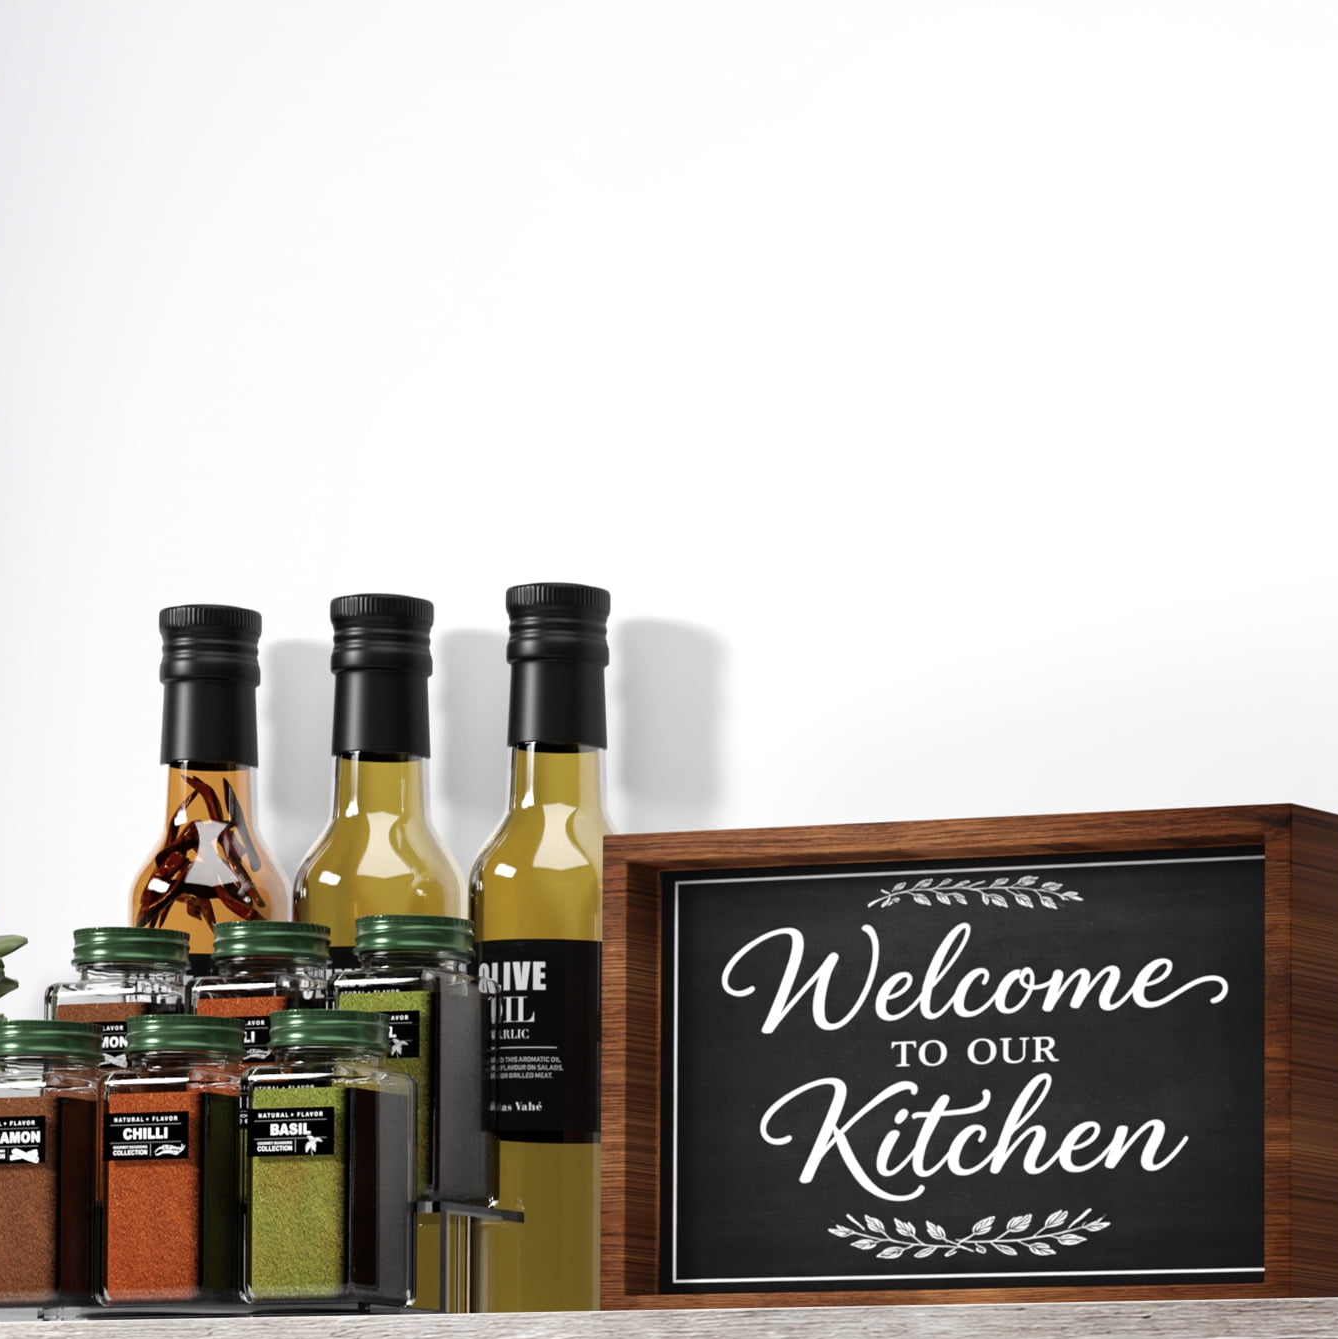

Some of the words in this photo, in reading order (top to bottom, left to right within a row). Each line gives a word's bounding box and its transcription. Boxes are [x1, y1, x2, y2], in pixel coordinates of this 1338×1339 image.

[721, 922, 1229, 1034] Welcome
[102, 1024, 125, 1032] LAVOR
[490, 1028, 530, 1040] RLIC
[891, 1040, 948, 1067] TO
[967, 1036, 1060, 1065] OUR
[122, 1126, 169, 1141] CHILLI
[269, 1122, 312, 1136] BASIL
[760, 1072, 1189, 1202] Kitchen
